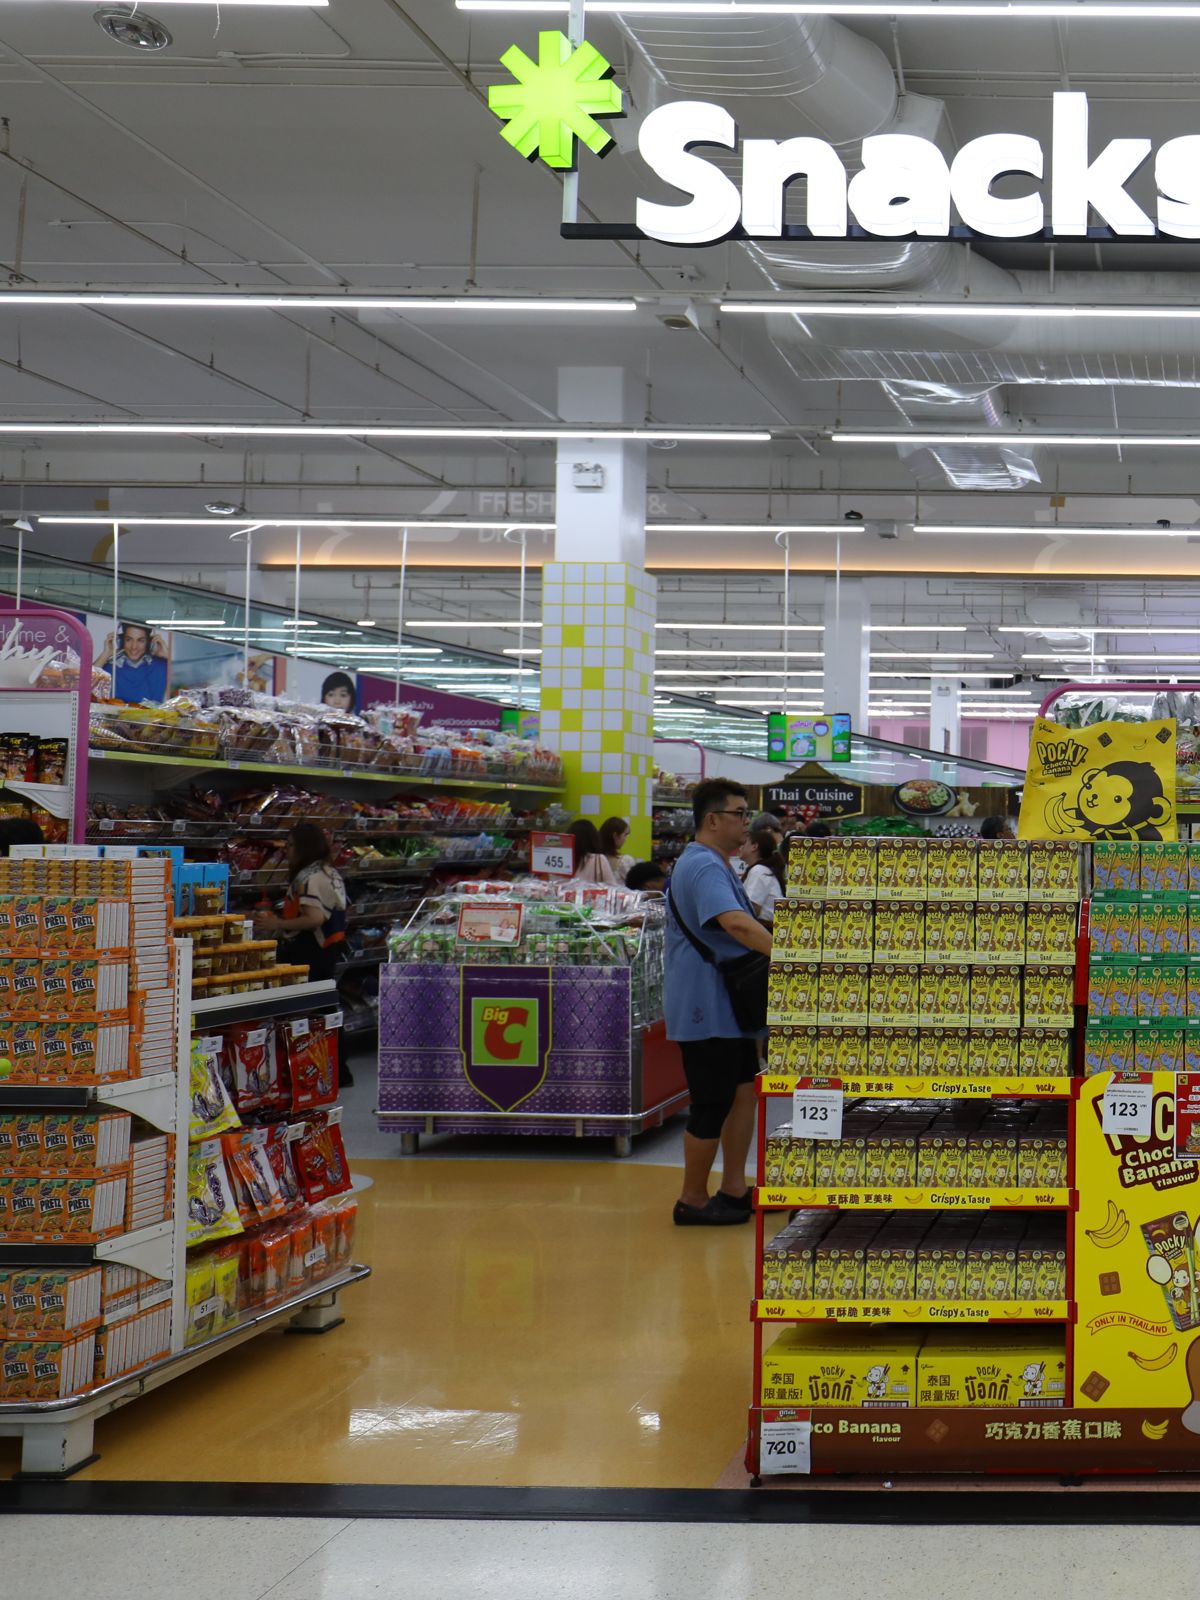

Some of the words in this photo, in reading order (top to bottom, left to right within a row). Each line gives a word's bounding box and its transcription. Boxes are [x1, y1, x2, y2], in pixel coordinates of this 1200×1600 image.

[1043, 765, 1071, 775] Banana
[768, 788, 799, 801] Thai
[805, 788, 854, 801] Cuisine
[544, 855, 564, 868] 455
[15, 915, 37, 927] PRETZ
[45, 915, 67, 928] PRETZ
[72, 916, 94, 928] PRETZ
[14, 976, 36, 989] PRETZ
[44, 978, 66, 991] PRETZ
[71, 978, 94, 991] PRETZ
[481, 1007, 508, 1025] Big
[484, 1007, 529, 1060] C
[14, 1041, 36, 1054] PRETZ
[44, 1040, 66, 1054] PRETZ
[71, 1041, 93, 1054] PRETZ
[865, 1081, 894, 1093] 更美味
[931, 1081, 961, 1094] Crispy
[968, 1083, 992, 1093] Taste
[800, 1106, 829, 1121] 123
[1109, 1102, 1138, 1117] 123
[17, 1134, 38, 1146] PRETZ
[45, 1135, 67, 1147] PRETZ
[72, 1135, 94, 1147] PRETZ
[1125, 1146, 1173, 1167] Choc
[1122, 1160, 1194, 1184] Banana
[13, 1198, 34, 1210] PRETZ
[40, 1198, 62, 1211] PRETZ
[68, 1199, 90, 1211] PRETZ
[826, 1193, 860, 1205] 更酥脆
[863, 1193, 893, 1204] 更美味
[930, 1193, 960, 1205] Crispy
[967, 1194, 991, 1204] Taste
[309, 1252, 316, 1261] 51
[13, 1295, 35, 1308] PRETZ
[41, 1295, 64, 1308] PRETZ
[200, 1304, 209, 1313] 51
[824, 1306, 858, 1318] 更酥脆
[862, 1306, 891, 1317] 更美味
[929, 1306, 959, 1318] Crispy
[966, 1308, 989, 1317] Taste
[1094, 1314, 1115, 1328] ONLY
[1117, 1315, 1125, 1323] IN
[1128, 1317, 1168, 1334] THAILAND
[5, 1363, 28, 1375] PRETZ
[34, 1363, 57, 1376] PRETZ
[771, 1373, 795, 1385] 泰国
[927, 1375, 951, 1387] 泰国
[763, 1388, 803, 1400] 限量版!
[808, 1374, 857, 1402] ป๊อกกี้
[964, 1374, 1014, 1402] ป๊อกกี้
[920, 1389, 960, 1401] 限量版!
[838, 1420, 901, 1434] Banana
[985, 1419, 1122, 1440] 巧克力香蕉口味
[766, 1440, 796, 1455] 720
